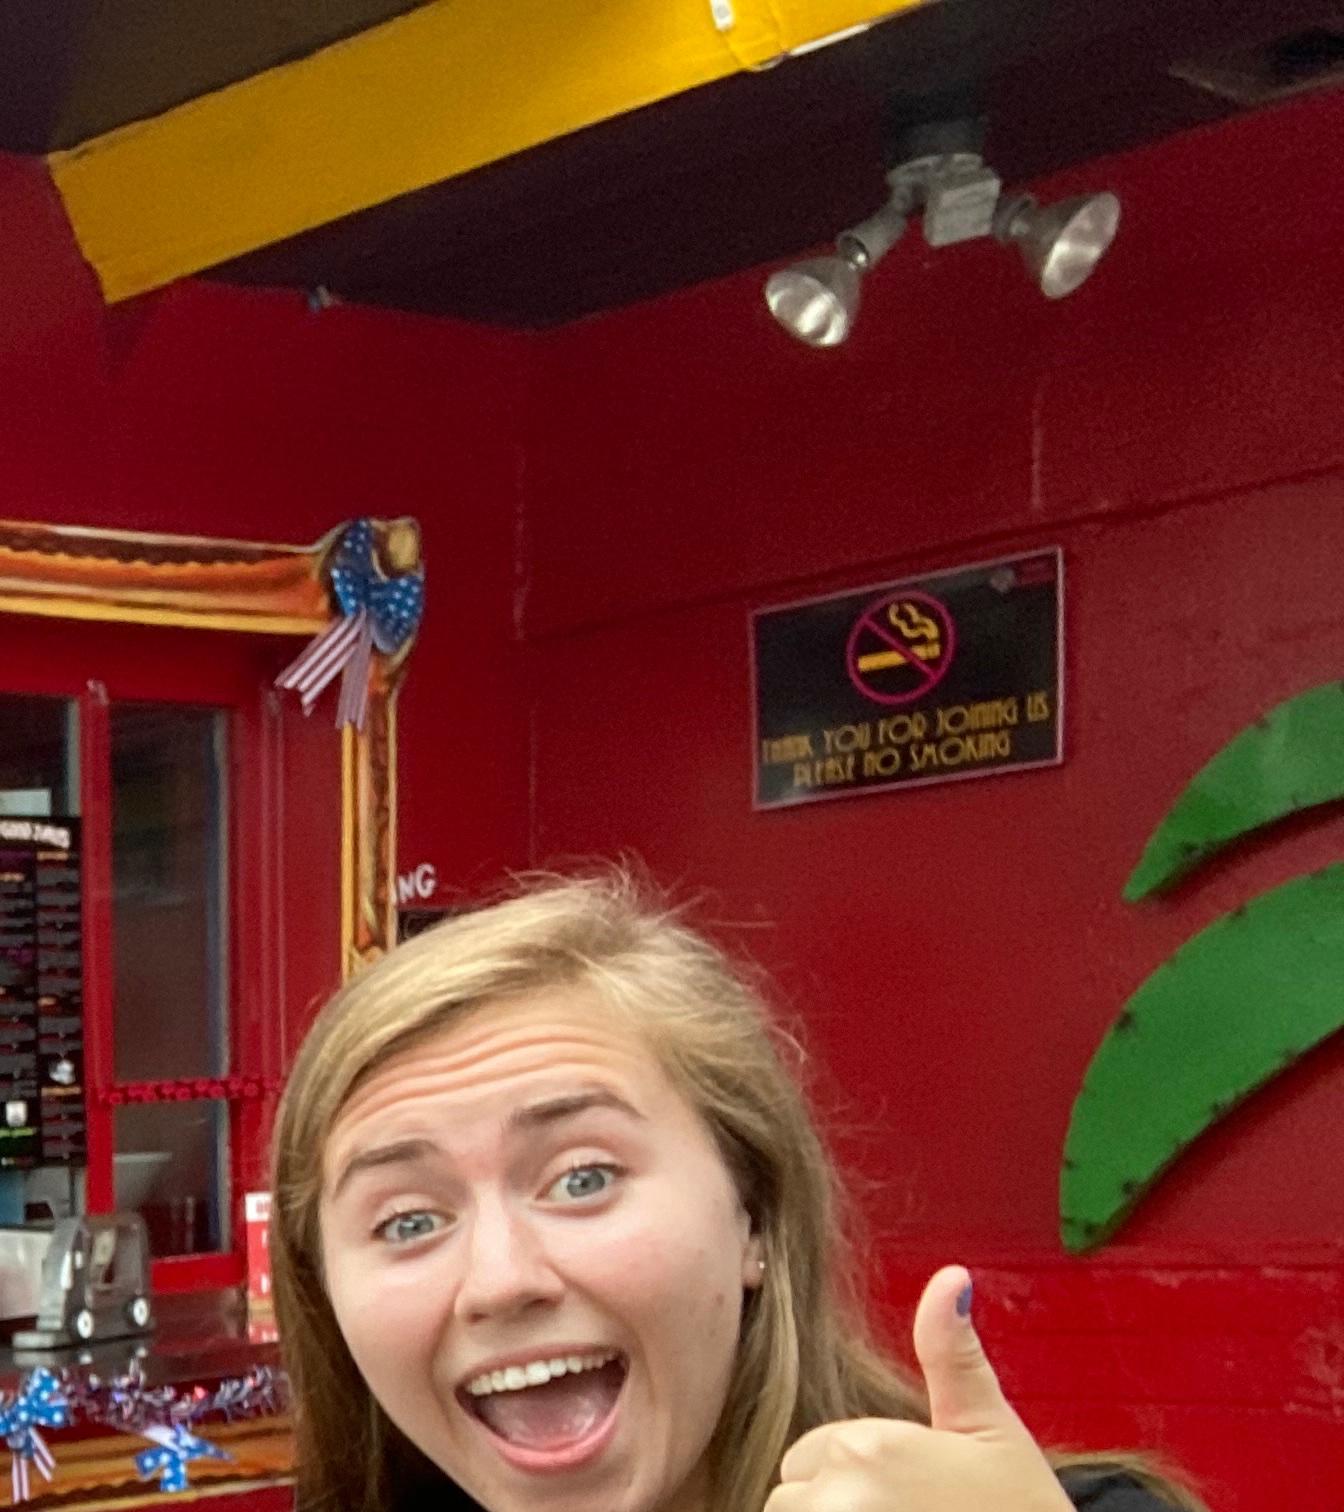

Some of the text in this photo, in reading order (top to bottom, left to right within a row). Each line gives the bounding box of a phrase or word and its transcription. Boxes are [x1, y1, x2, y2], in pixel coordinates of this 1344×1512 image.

[824, 722, 871, 754] YOU
[878, 712, 927, 745] FOR
[1027, 692, 1050, 722] US
[864, 746, 901, 777] NO
[909, 729, 1010, 771] SMOKING
